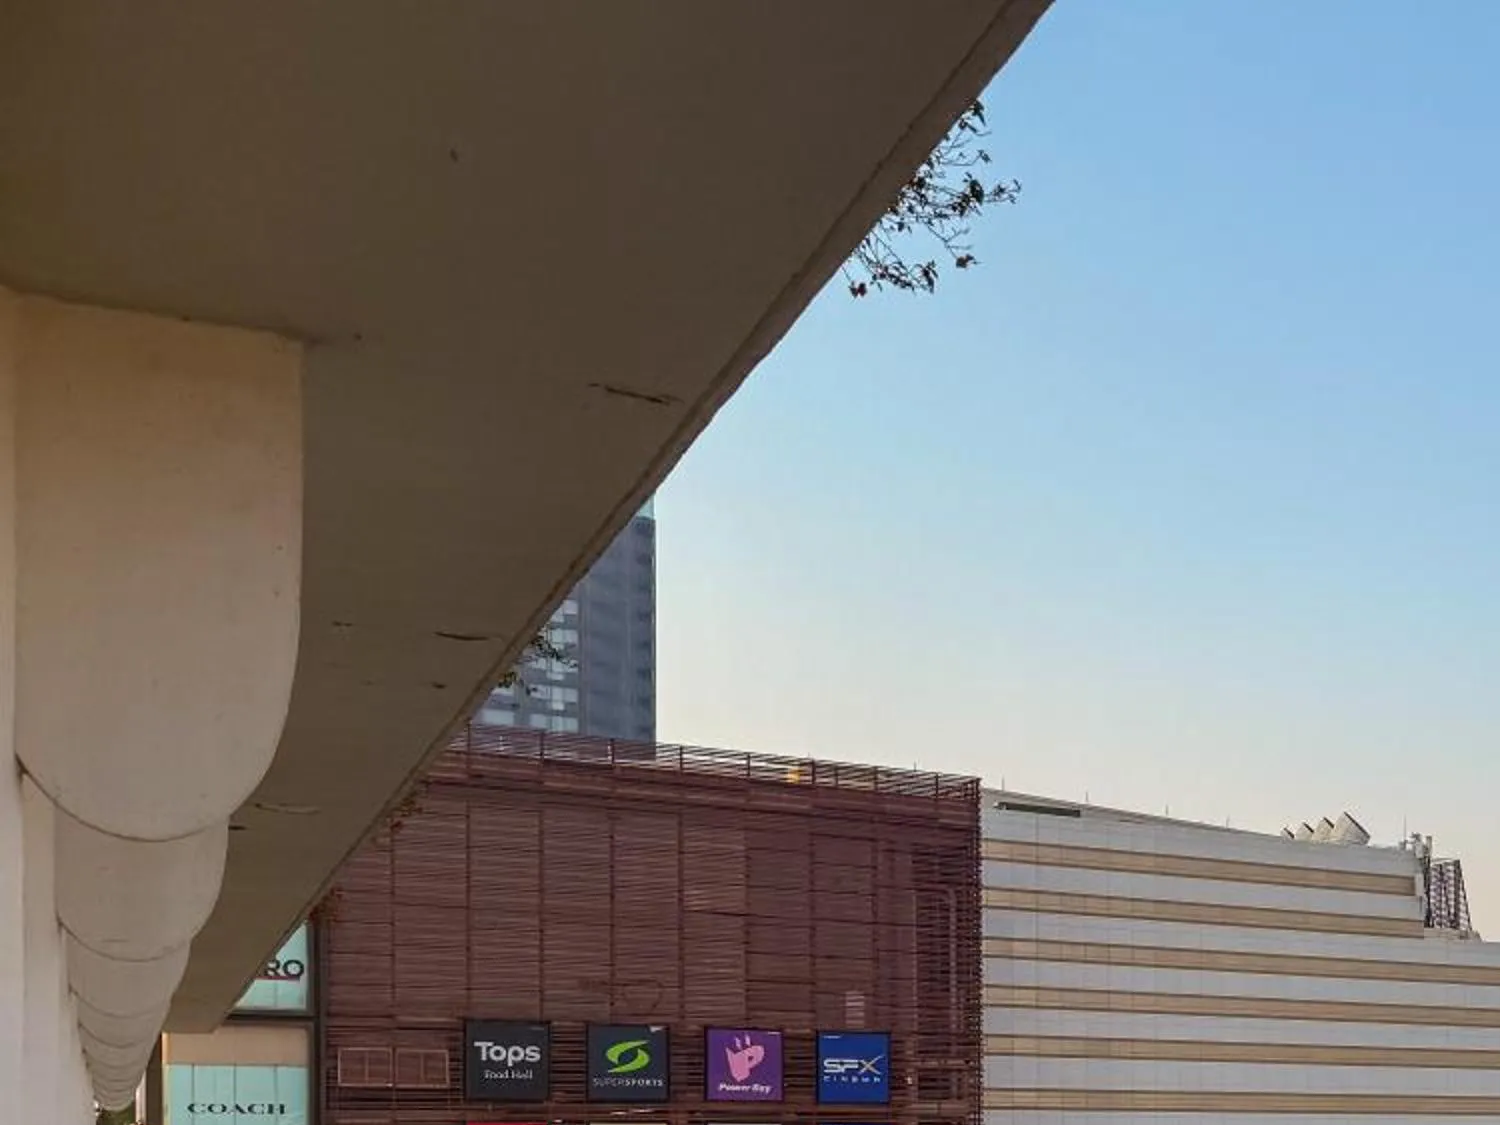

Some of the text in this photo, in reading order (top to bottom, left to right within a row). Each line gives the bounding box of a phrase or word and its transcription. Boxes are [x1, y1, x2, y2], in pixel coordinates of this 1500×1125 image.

[262, 959, 304, 977] RO
[474, 1041, 541, 1067] Tops
[484, 1069, 508, 1080] Food
[187, 1103, 287, 1115] COACH
